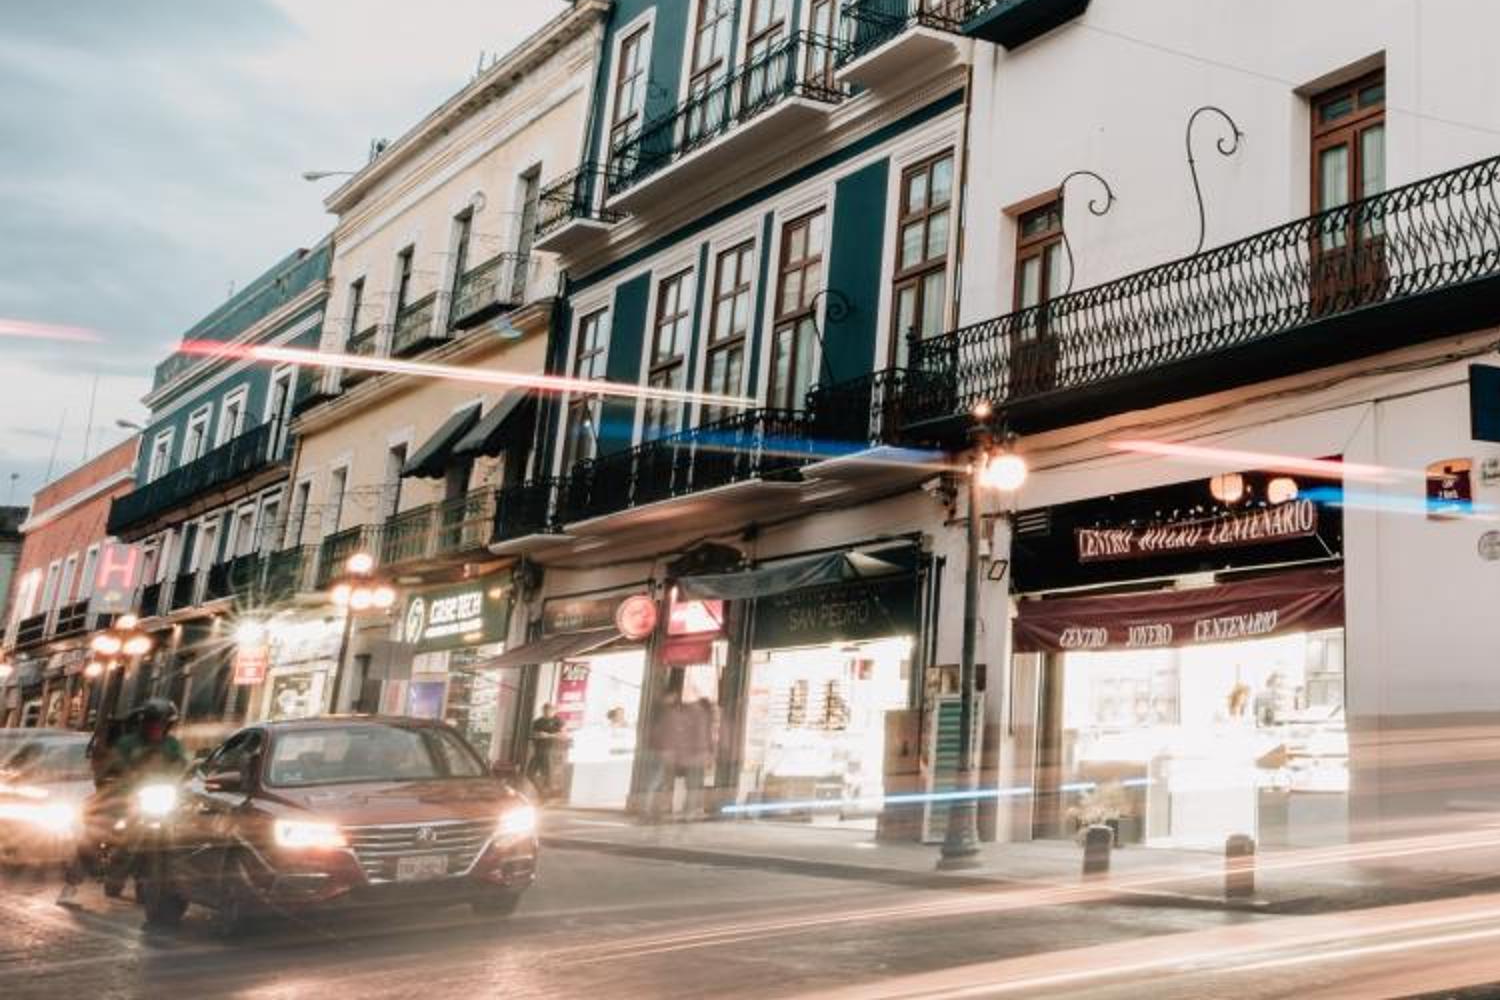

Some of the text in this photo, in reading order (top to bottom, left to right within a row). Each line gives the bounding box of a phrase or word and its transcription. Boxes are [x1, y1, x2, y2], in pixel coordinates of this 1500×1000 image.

[1208, 500, 1314, 544] CENTENARIO
[1060, 610, 1279, 648] CENTRO JOYERO CENTENARIO
